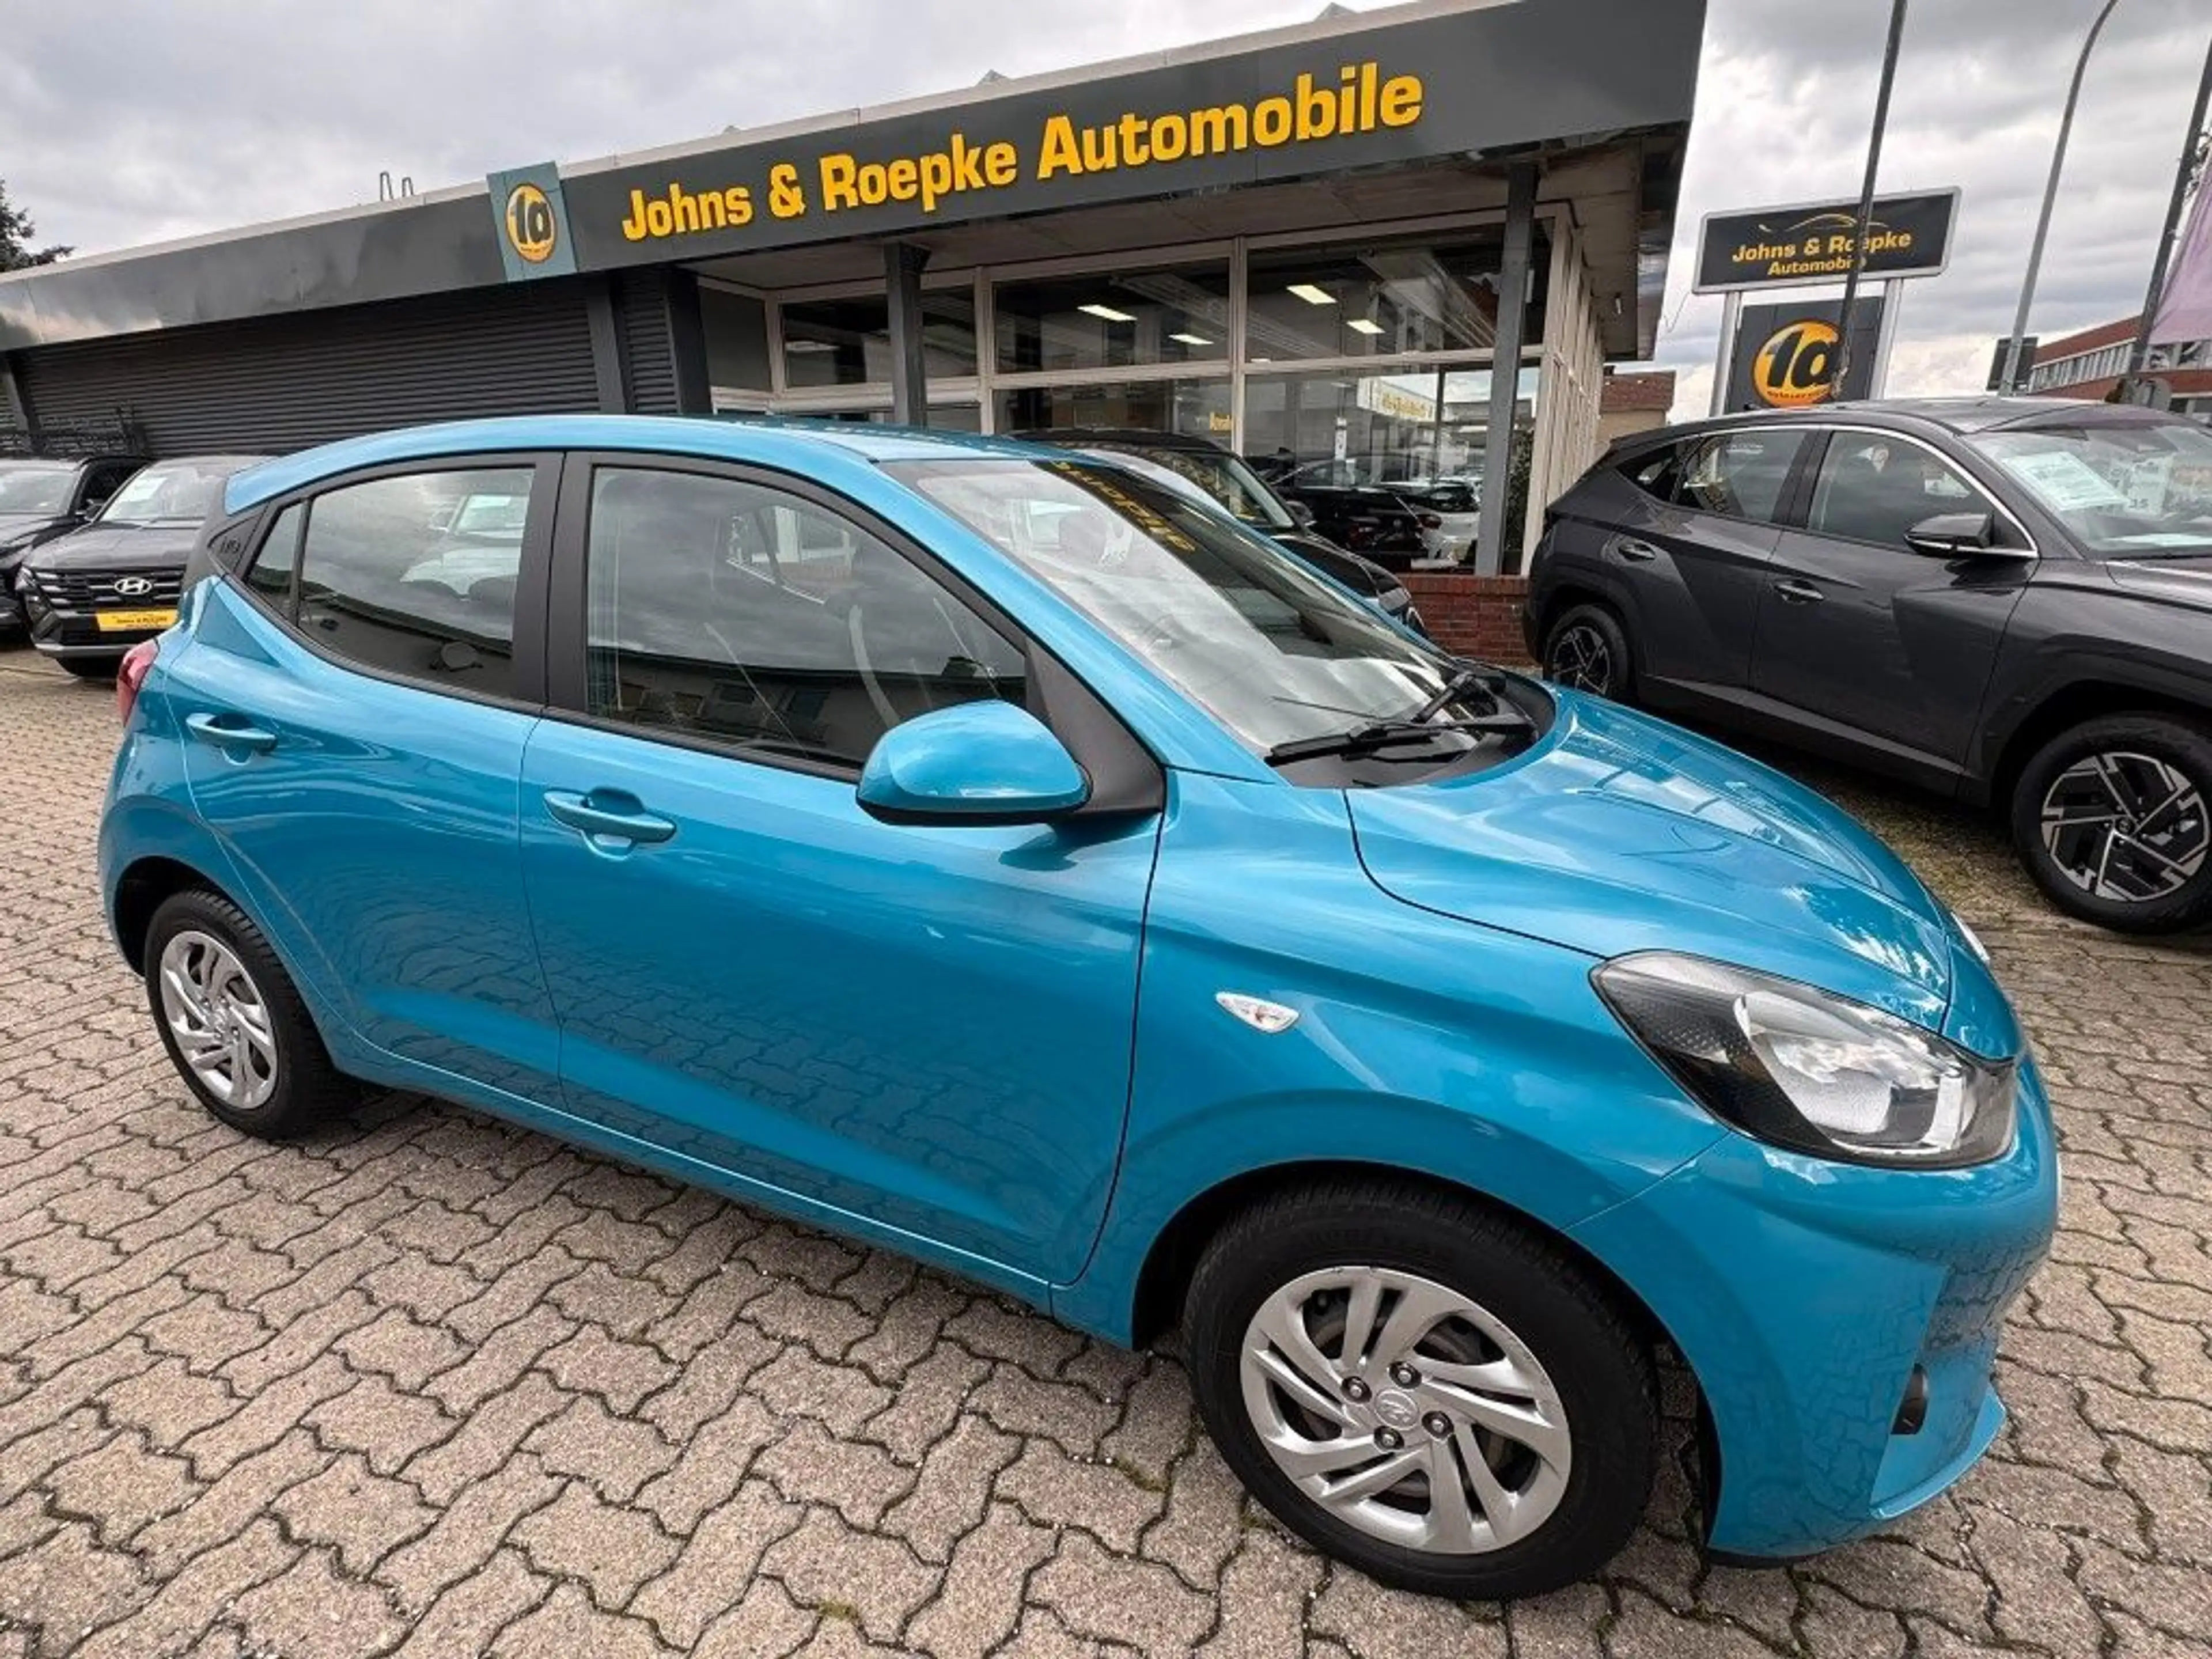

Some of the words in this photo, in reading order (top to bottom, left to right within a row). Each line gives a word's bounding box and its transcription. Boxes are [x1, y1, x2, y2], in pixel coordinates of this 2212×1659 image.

[622, 184, 753, 241] Johns
[769, 164, 806, 218] &
[820, 135, 1017, 210] Roepke
[1037, 62, 1423, 179] Automobile
[1732, 243, 1797, 263] Johns
[1803, 237, 1823, 257] &
[1767, 254, 1867, 276] Automobi
